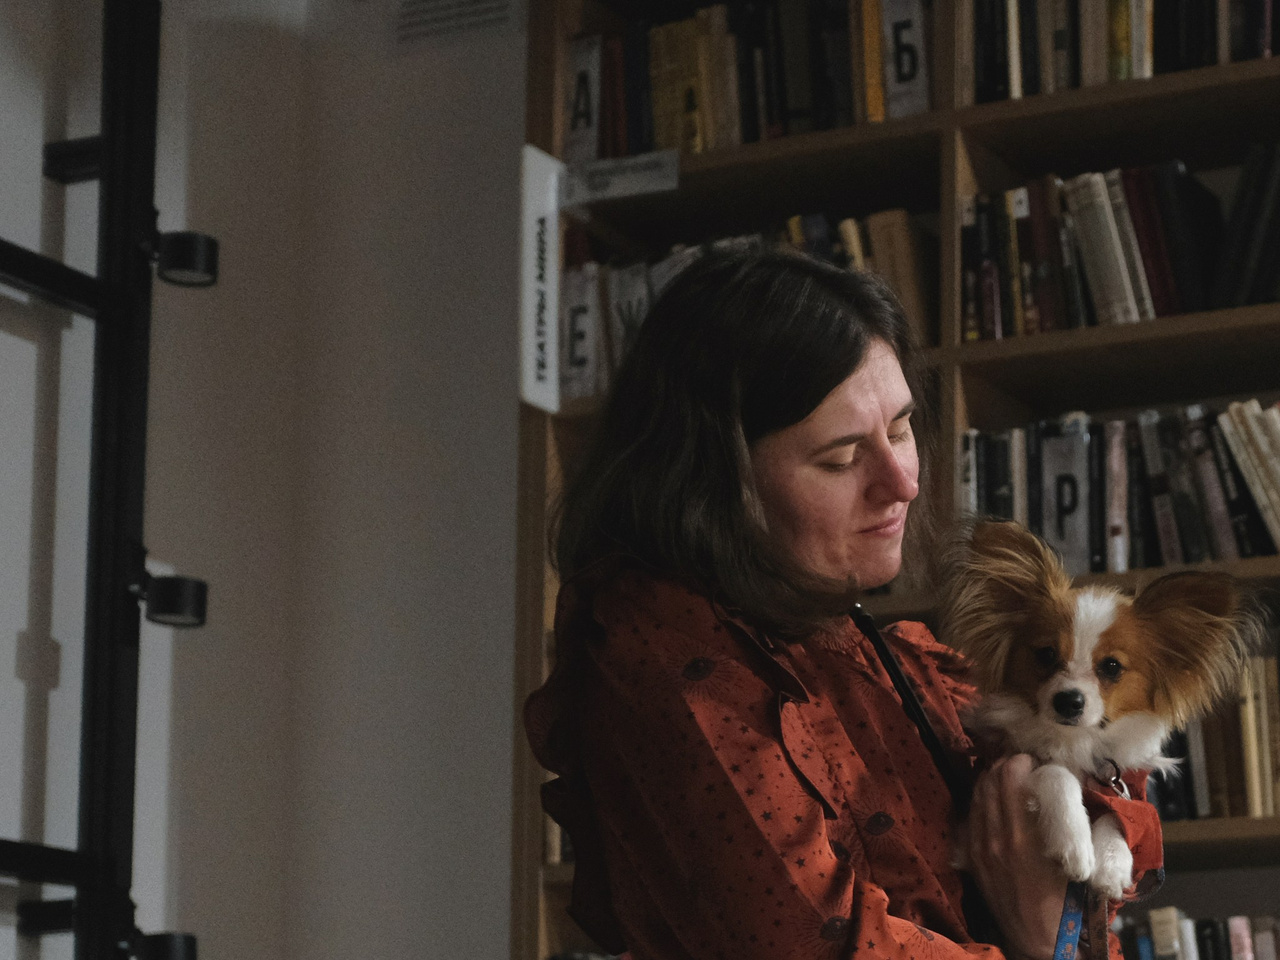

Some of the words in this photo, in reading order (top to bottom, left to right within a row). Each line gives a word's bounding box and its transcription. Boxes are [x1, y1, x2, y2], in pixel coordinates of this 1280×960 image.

[893, 20, 919, 83] Б
[571, 71, 592, 131] А
[569, 306, 588, 368] Е
[1055, 474, 1078, 531] Р
